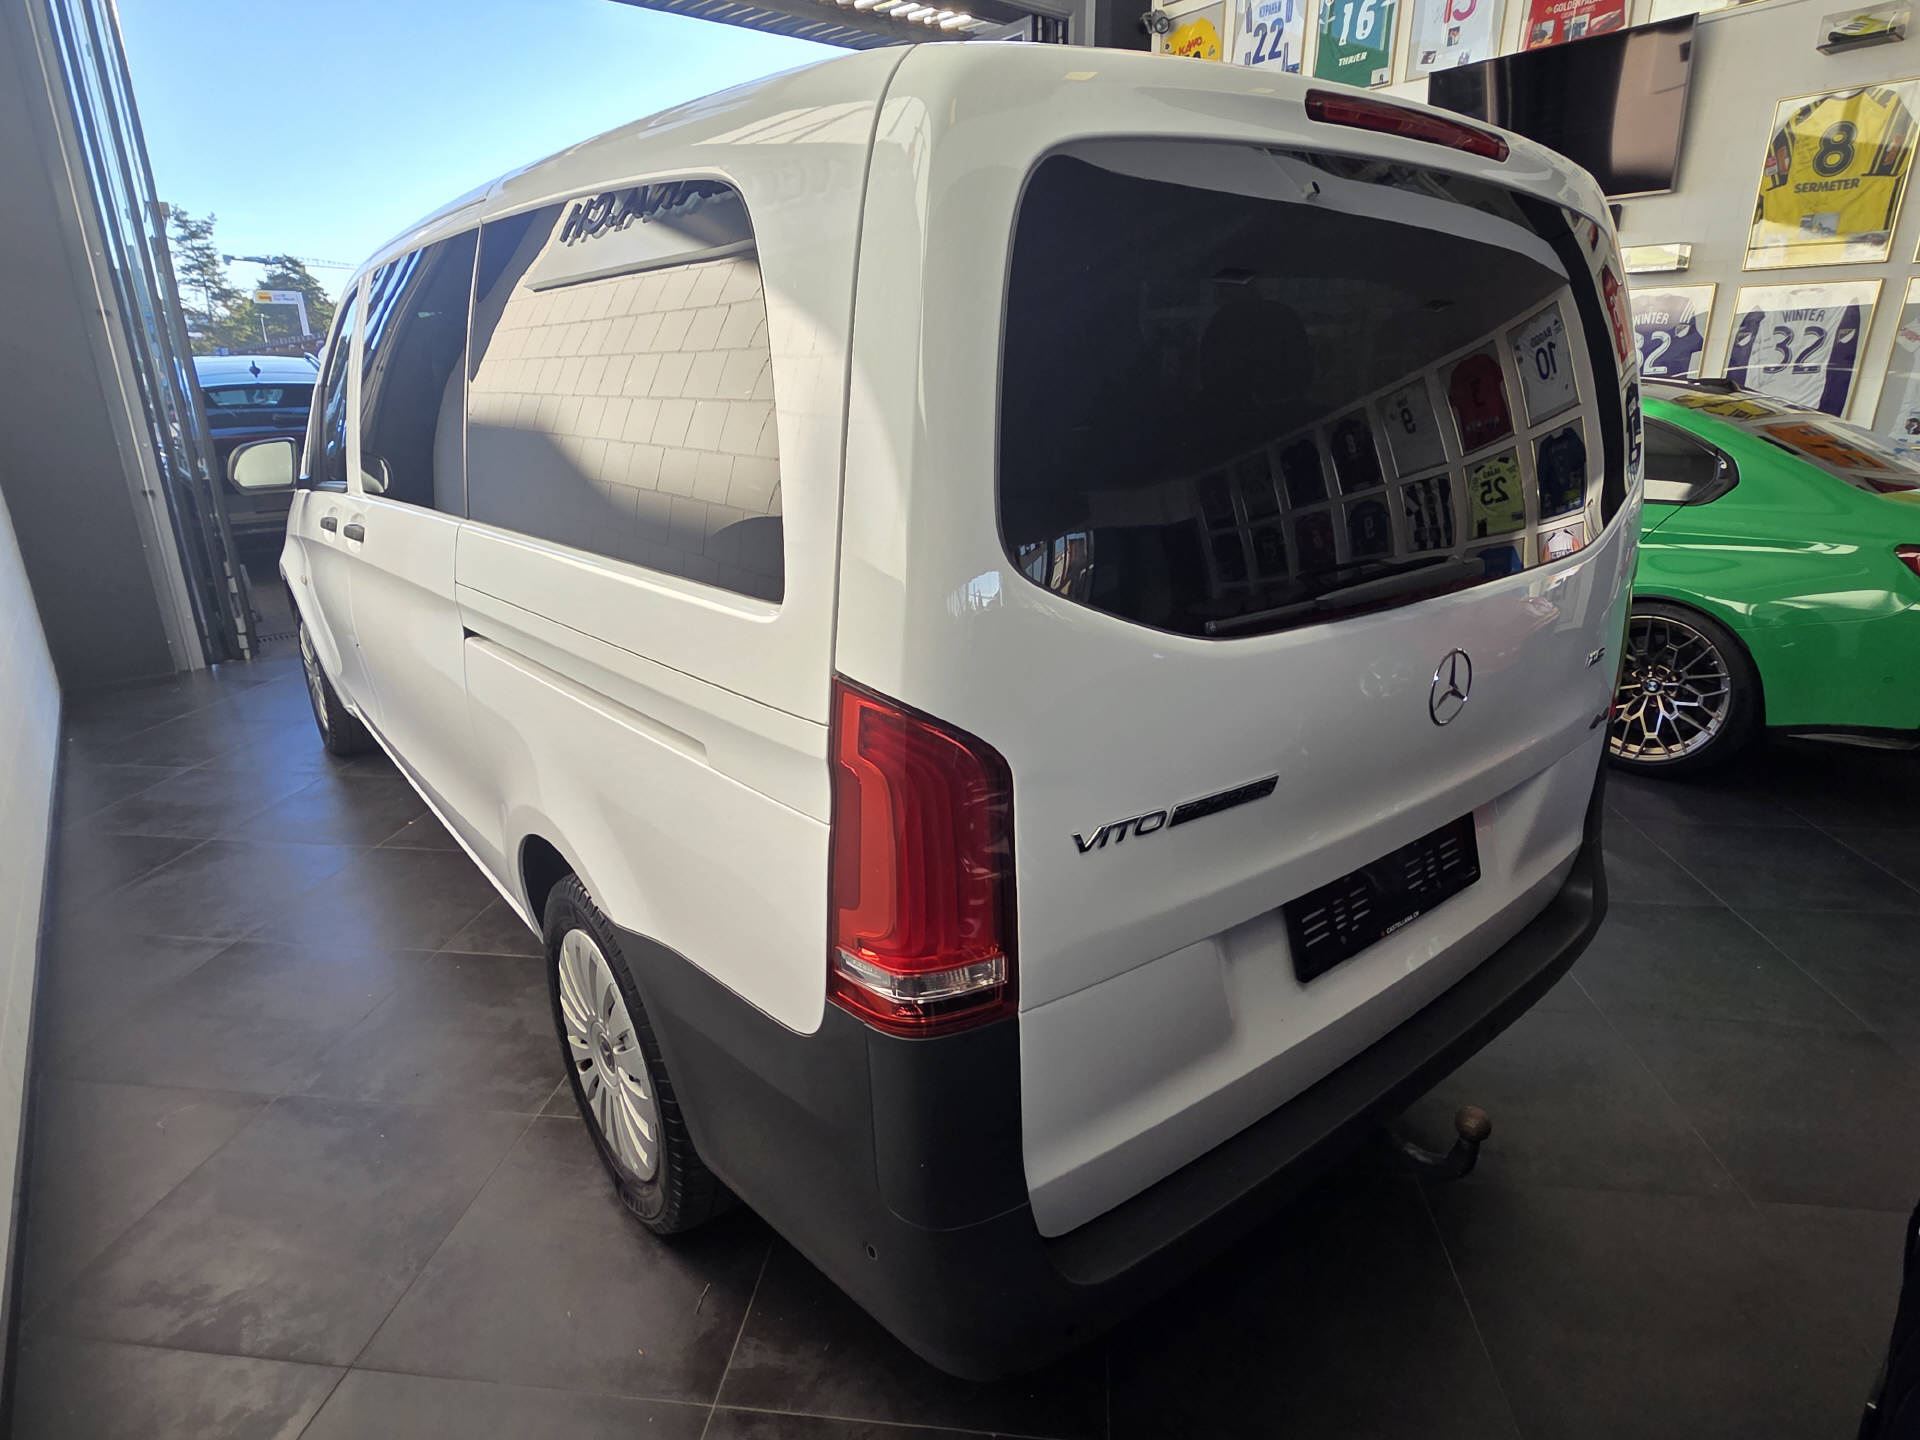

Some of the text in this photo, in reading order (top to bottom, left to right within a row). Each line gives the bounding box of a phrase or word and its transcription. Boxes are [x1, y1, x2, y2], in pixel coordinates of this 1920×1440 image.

[1252, 17, 1284, 64] 22
[1338, 0, 1378, 46] 16
[1813, 120, 1858, 178] 8
[1794, 178, 1861, 193] SERMETER
[1633, 310, 1670, 325] WINTER
[1782, 308, 1826, 323] WINTER
[1762, 325, 1828, 375] 32
[1072, 809, 1168, 854] VITO
